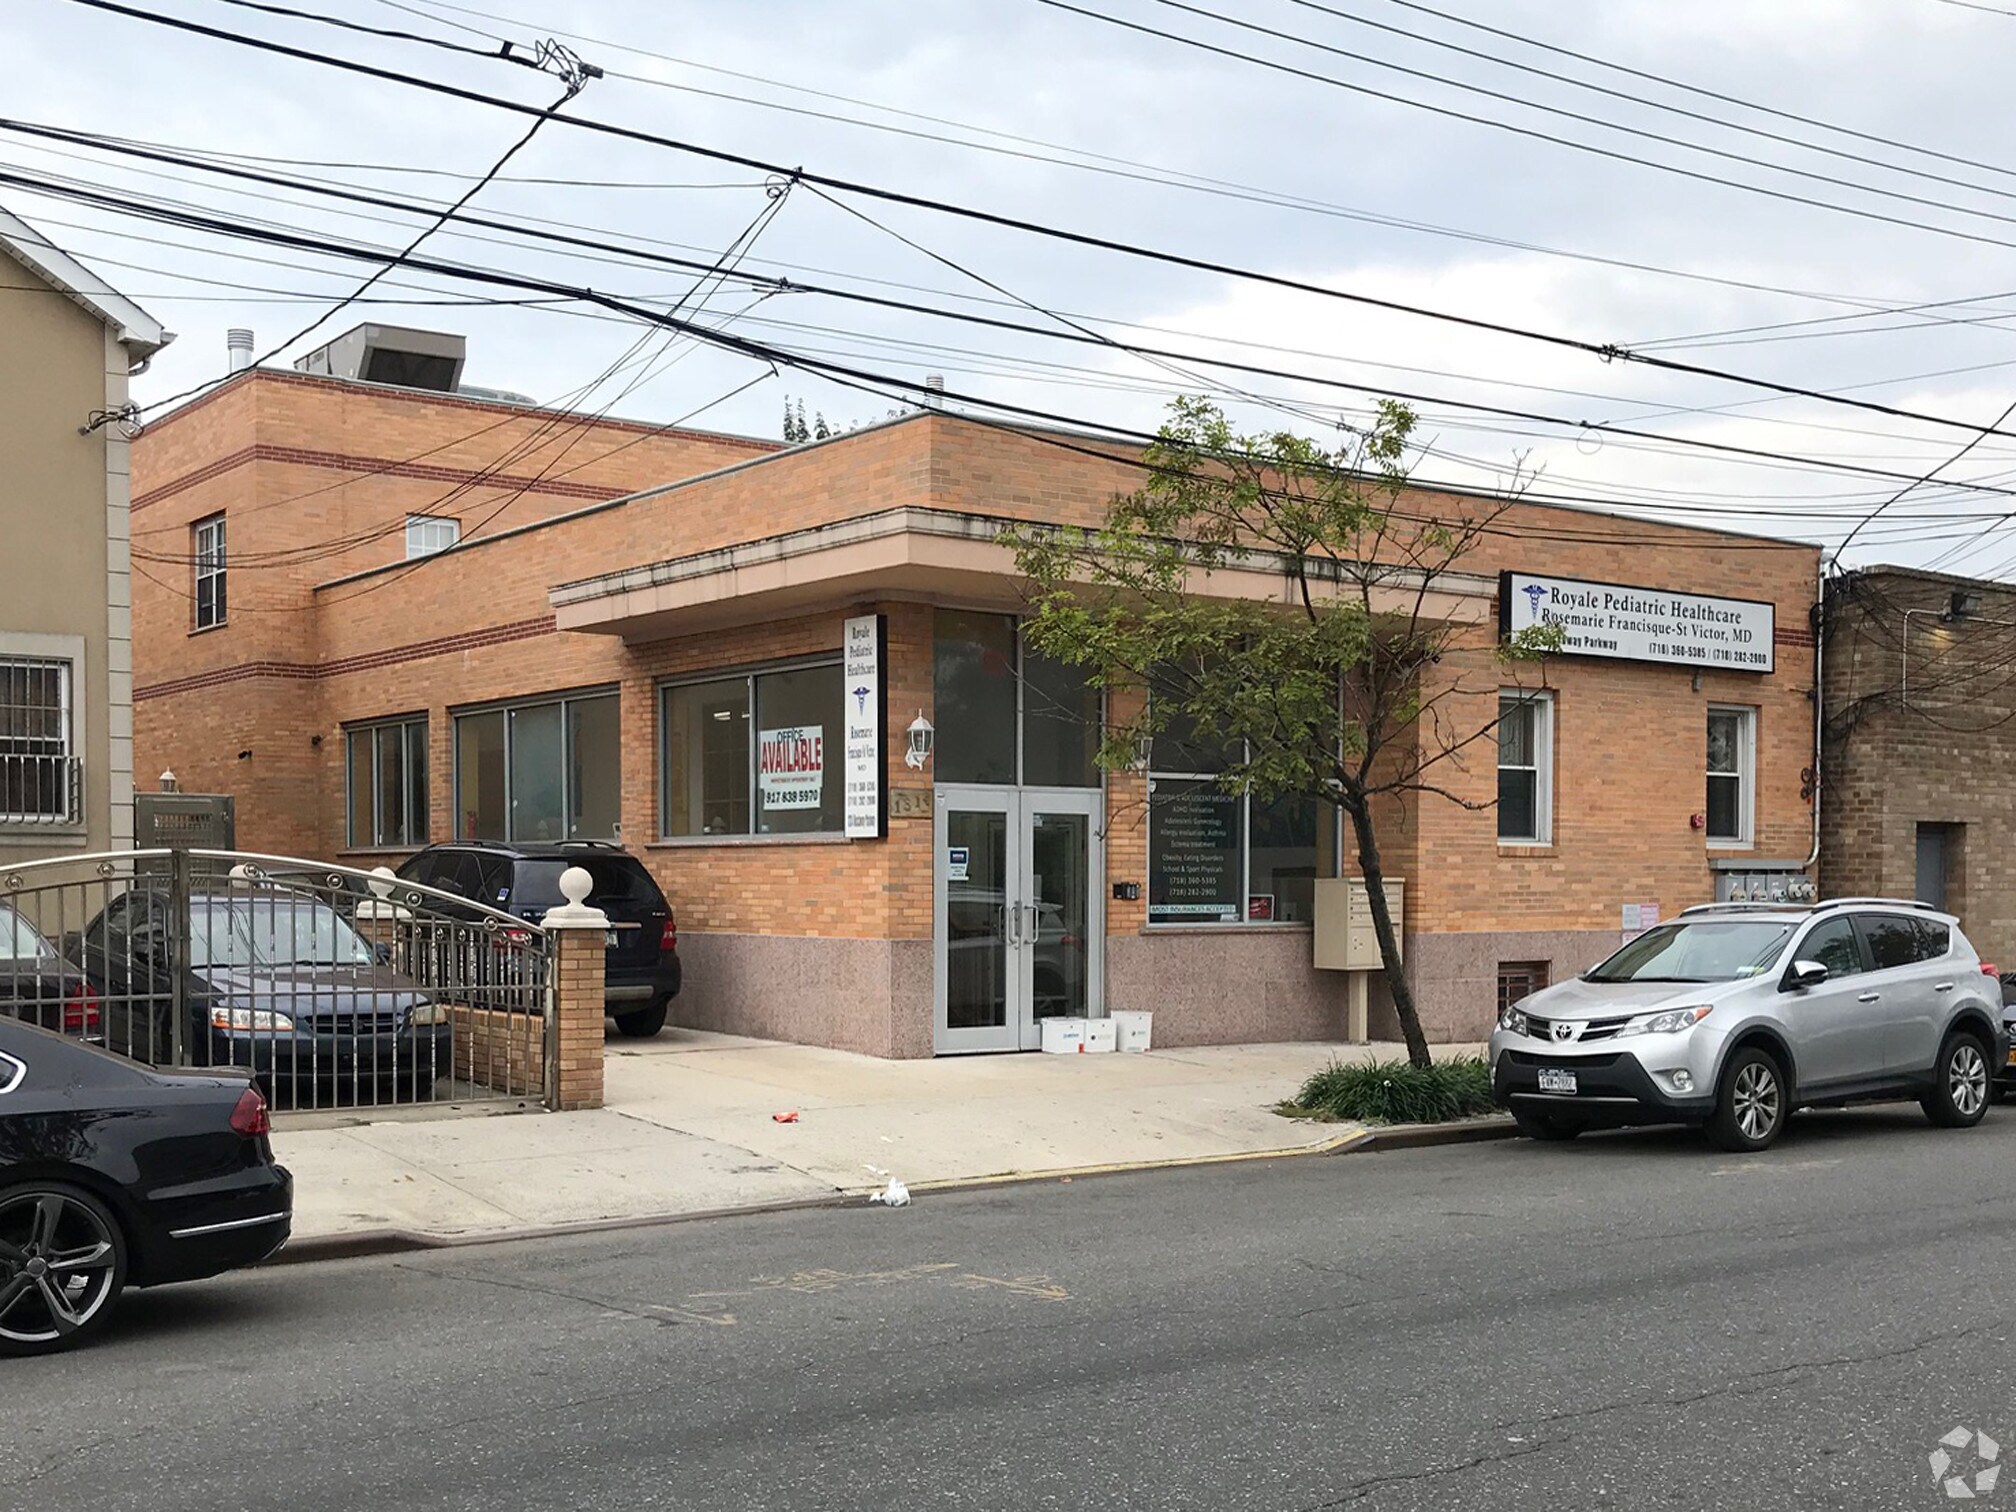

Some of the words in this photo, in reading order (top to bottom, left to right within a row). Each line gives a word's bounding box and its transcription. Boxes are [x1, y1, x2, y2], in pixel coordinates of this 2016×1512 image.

[1550, 586, 1598, 610] Royale
[1604, 592, 1666, 617] Pediatric
[1670, 600, 1742, 624] Healthcare
[1542, 607, 1605, 629] Rosemarie
[1609, 614, 1687, 637] Francisque-St
[1691, 623, 1729, 643] Victor,
[1733, 627, 1752, 643] MD
[1584, 635, 1618, 651] Parkway
[1649, 642, 1669, 656] (718)
[1713, 648, 1733, 661] (718)
[777, 730, 803, 744] OFFICE
[761, 737, 821, 773] AVAILABLE
